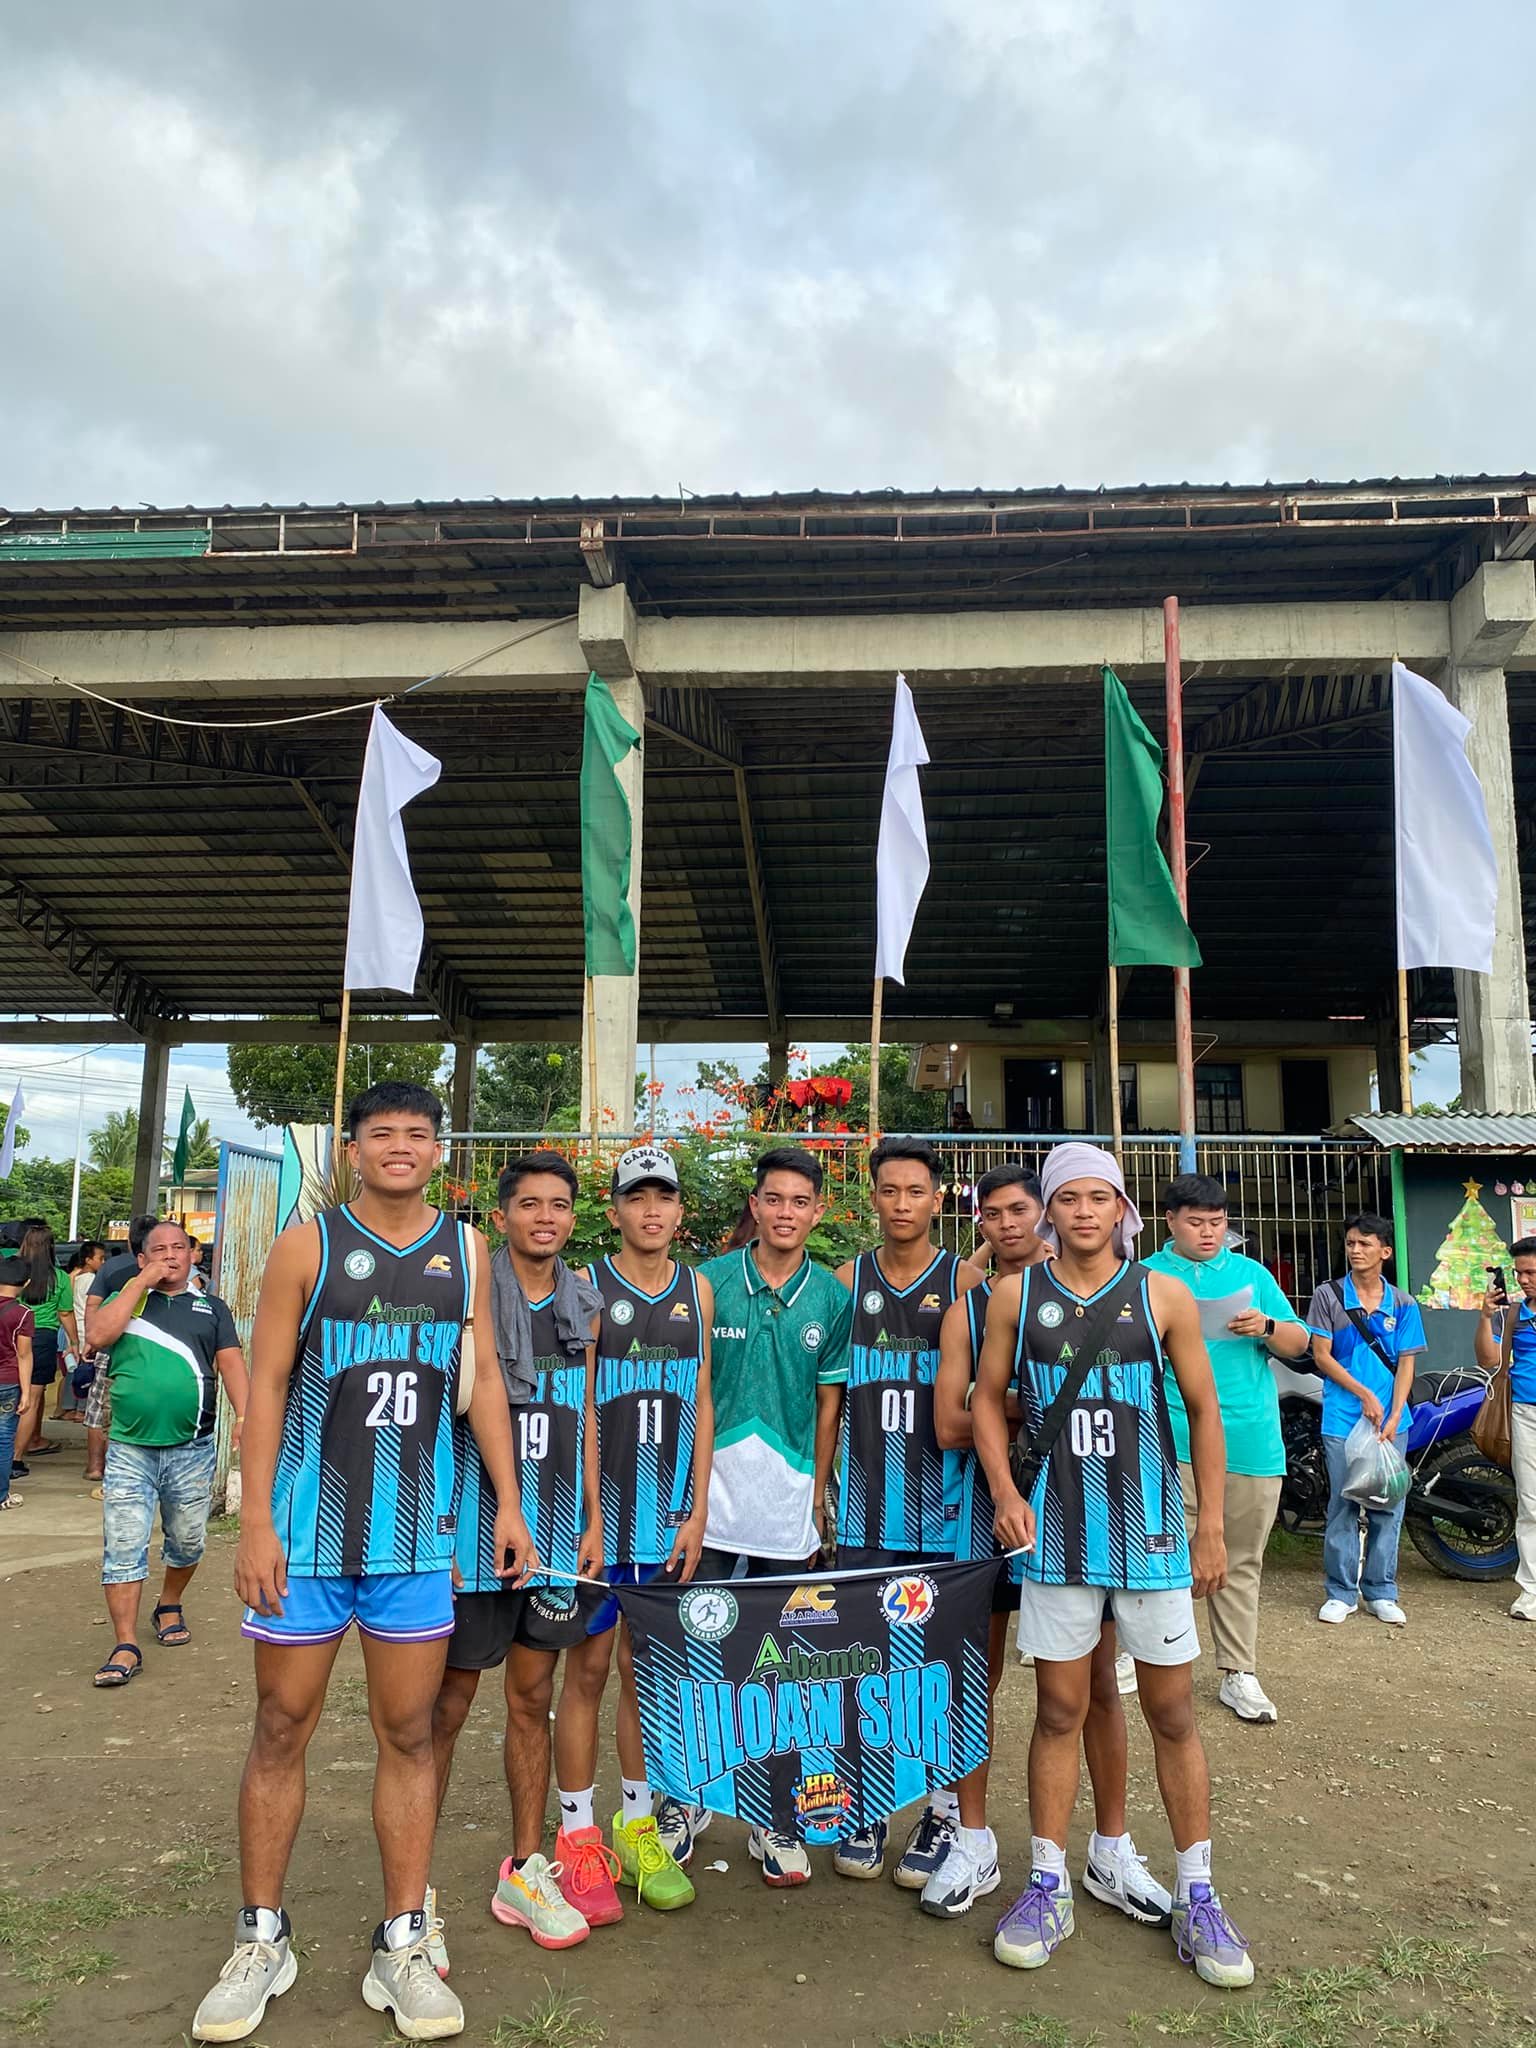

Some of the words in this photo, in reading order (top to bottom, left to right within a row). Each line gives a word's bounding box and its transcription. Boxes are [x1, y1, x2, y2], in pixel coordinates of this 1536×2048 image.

[624, 1149, 670, 1165] CANADA
[362, 1294, 435, 1323] Abante
[321, 1317, 411, 1380] LILOAN
[416, 1321, 460, 1372] SUR
[623, 1337, 678, 1361] Abante
[710, 1327, 746, 1341] YEAN
[874, 1327, 928, 1352] Abante
[365, 1371, 418, 1427] 26
[595, 1357, 663, 1406] LILOAN
[663, 1357, 698, 1405] SUR
[1108, 1362, 1153, 1414] SUR
[637, 1399, 662, 1445] 11
[881, 1389, 915, 1433] 01
[1070, 1408, 1116, 1457] 03
[518, 1412, 549, 1460] 19
[554, 1612, 568, 1622] ARE
[749, 1633, 882, 1684] Abante
[678, 1676, 845, 1791] LILOAN
[856, 1660, 952, 1772] SUR
[805, 1773, 836, 1793] HR
